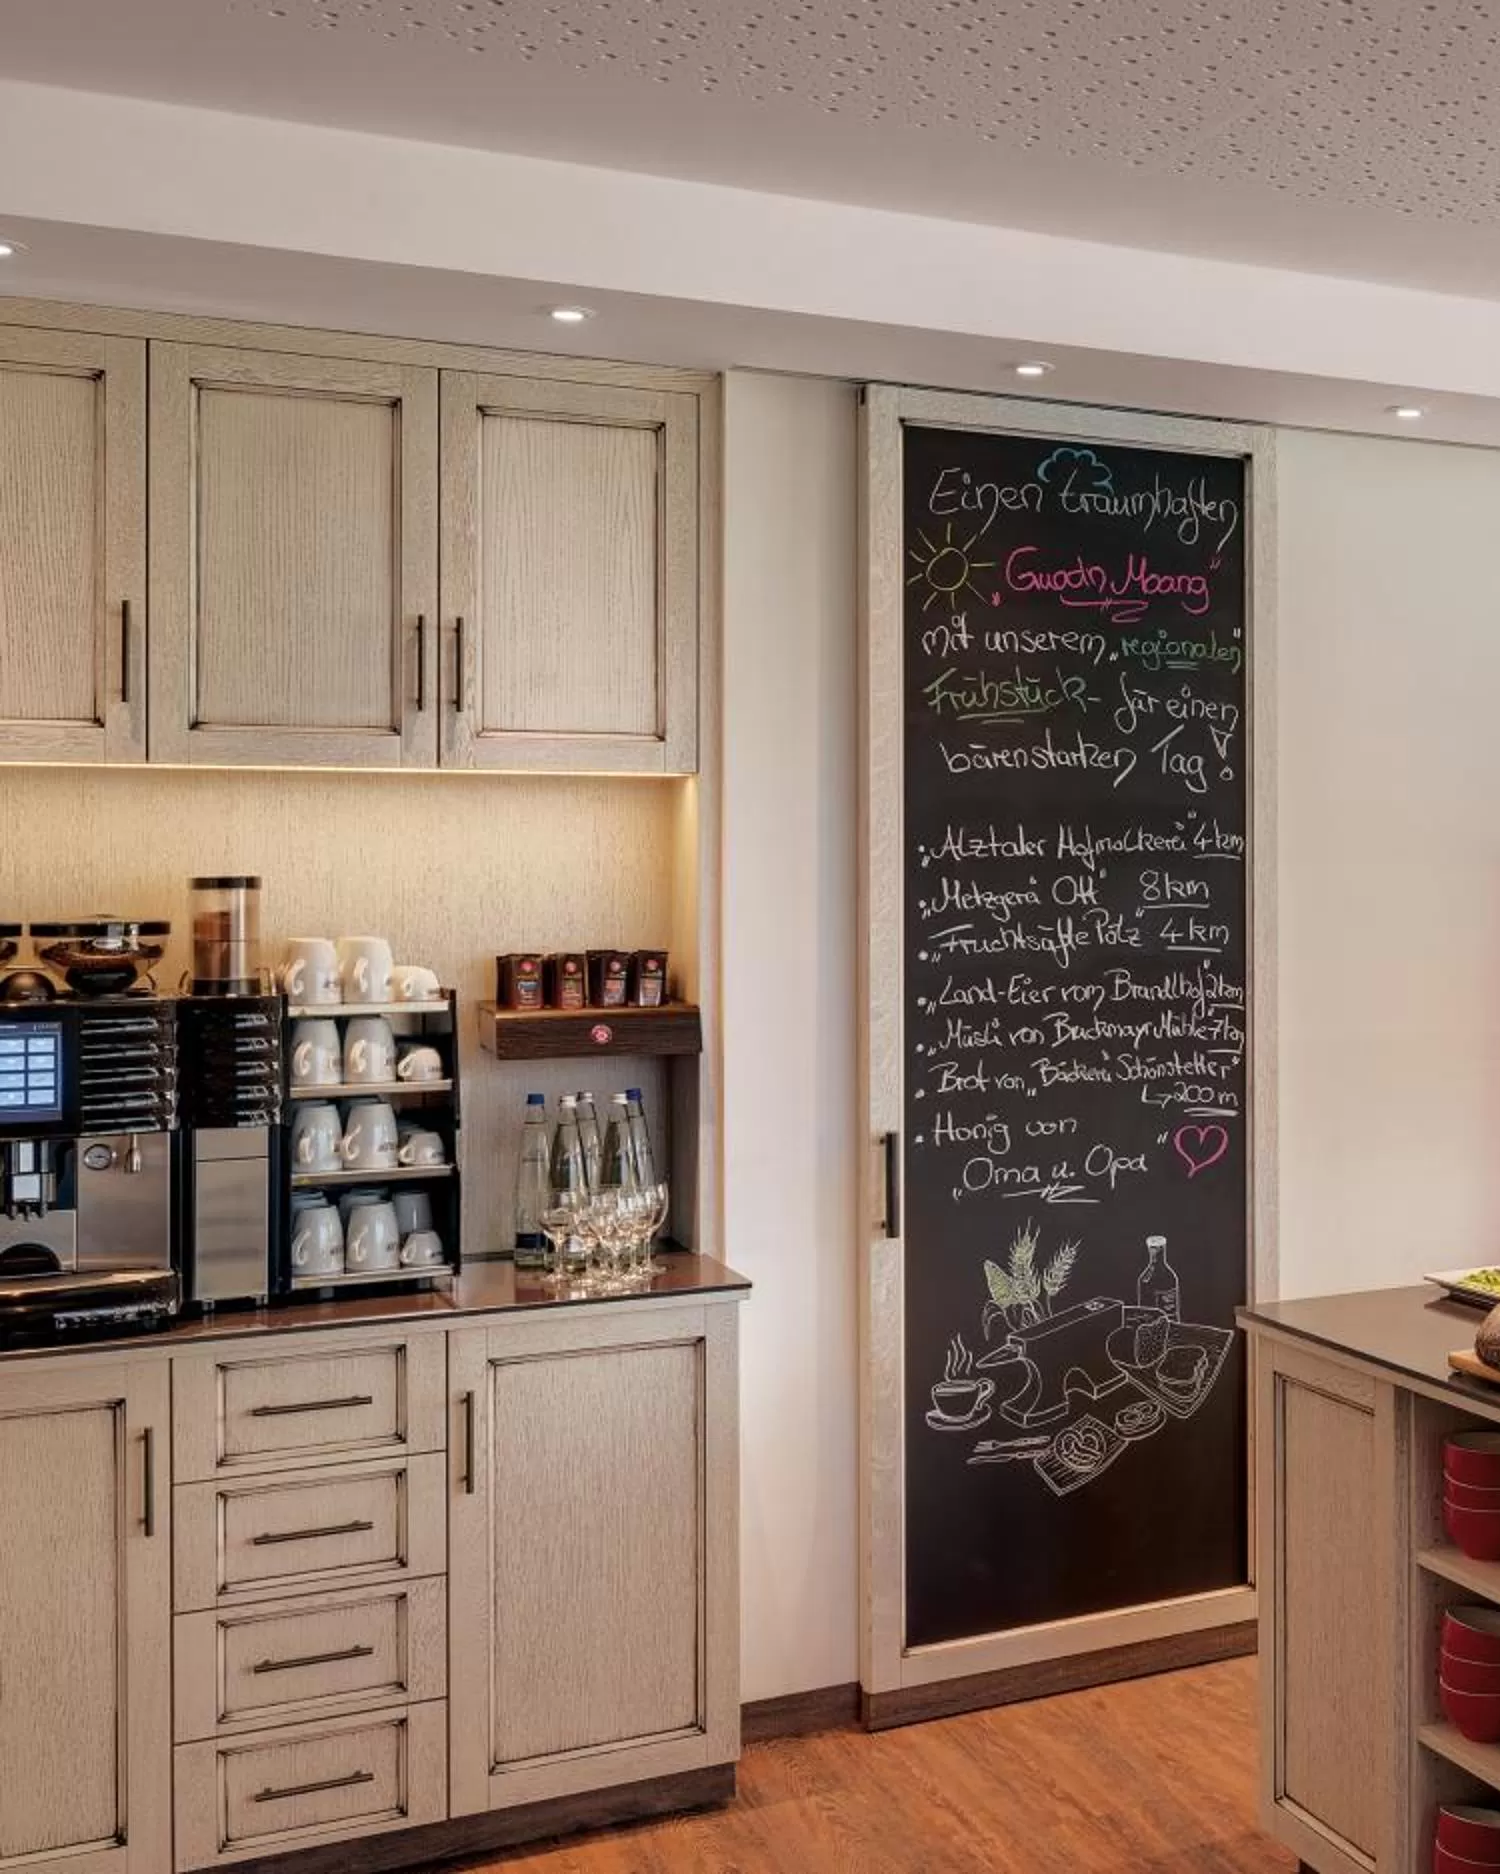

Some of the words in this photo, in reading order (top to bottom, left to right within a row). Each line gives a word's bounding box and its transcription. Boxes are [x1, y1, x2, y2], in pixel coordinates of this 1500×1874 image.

[929, 468, 1042, 536] Einen
[1058, 467, 1238, 554] traumhaften
[922, 612, 974, 657] mit
[1114, 671, 1160, 734] für
[1166, 683, 1239, 731] einen
[940, 728, 1136, 788] bärenstarken
[1061, 985, 1105, 1012] vom
[1009, 1027, 1045, 1046] von
[928, 1059, 990, 1093] Brot
[995, 1073, 1025, 1089] von
[932, 1110, 1010, 1154] Honig
[1025, 1118, 1077, 1136] von
[1052, 1160, 1075, 1179] u.
